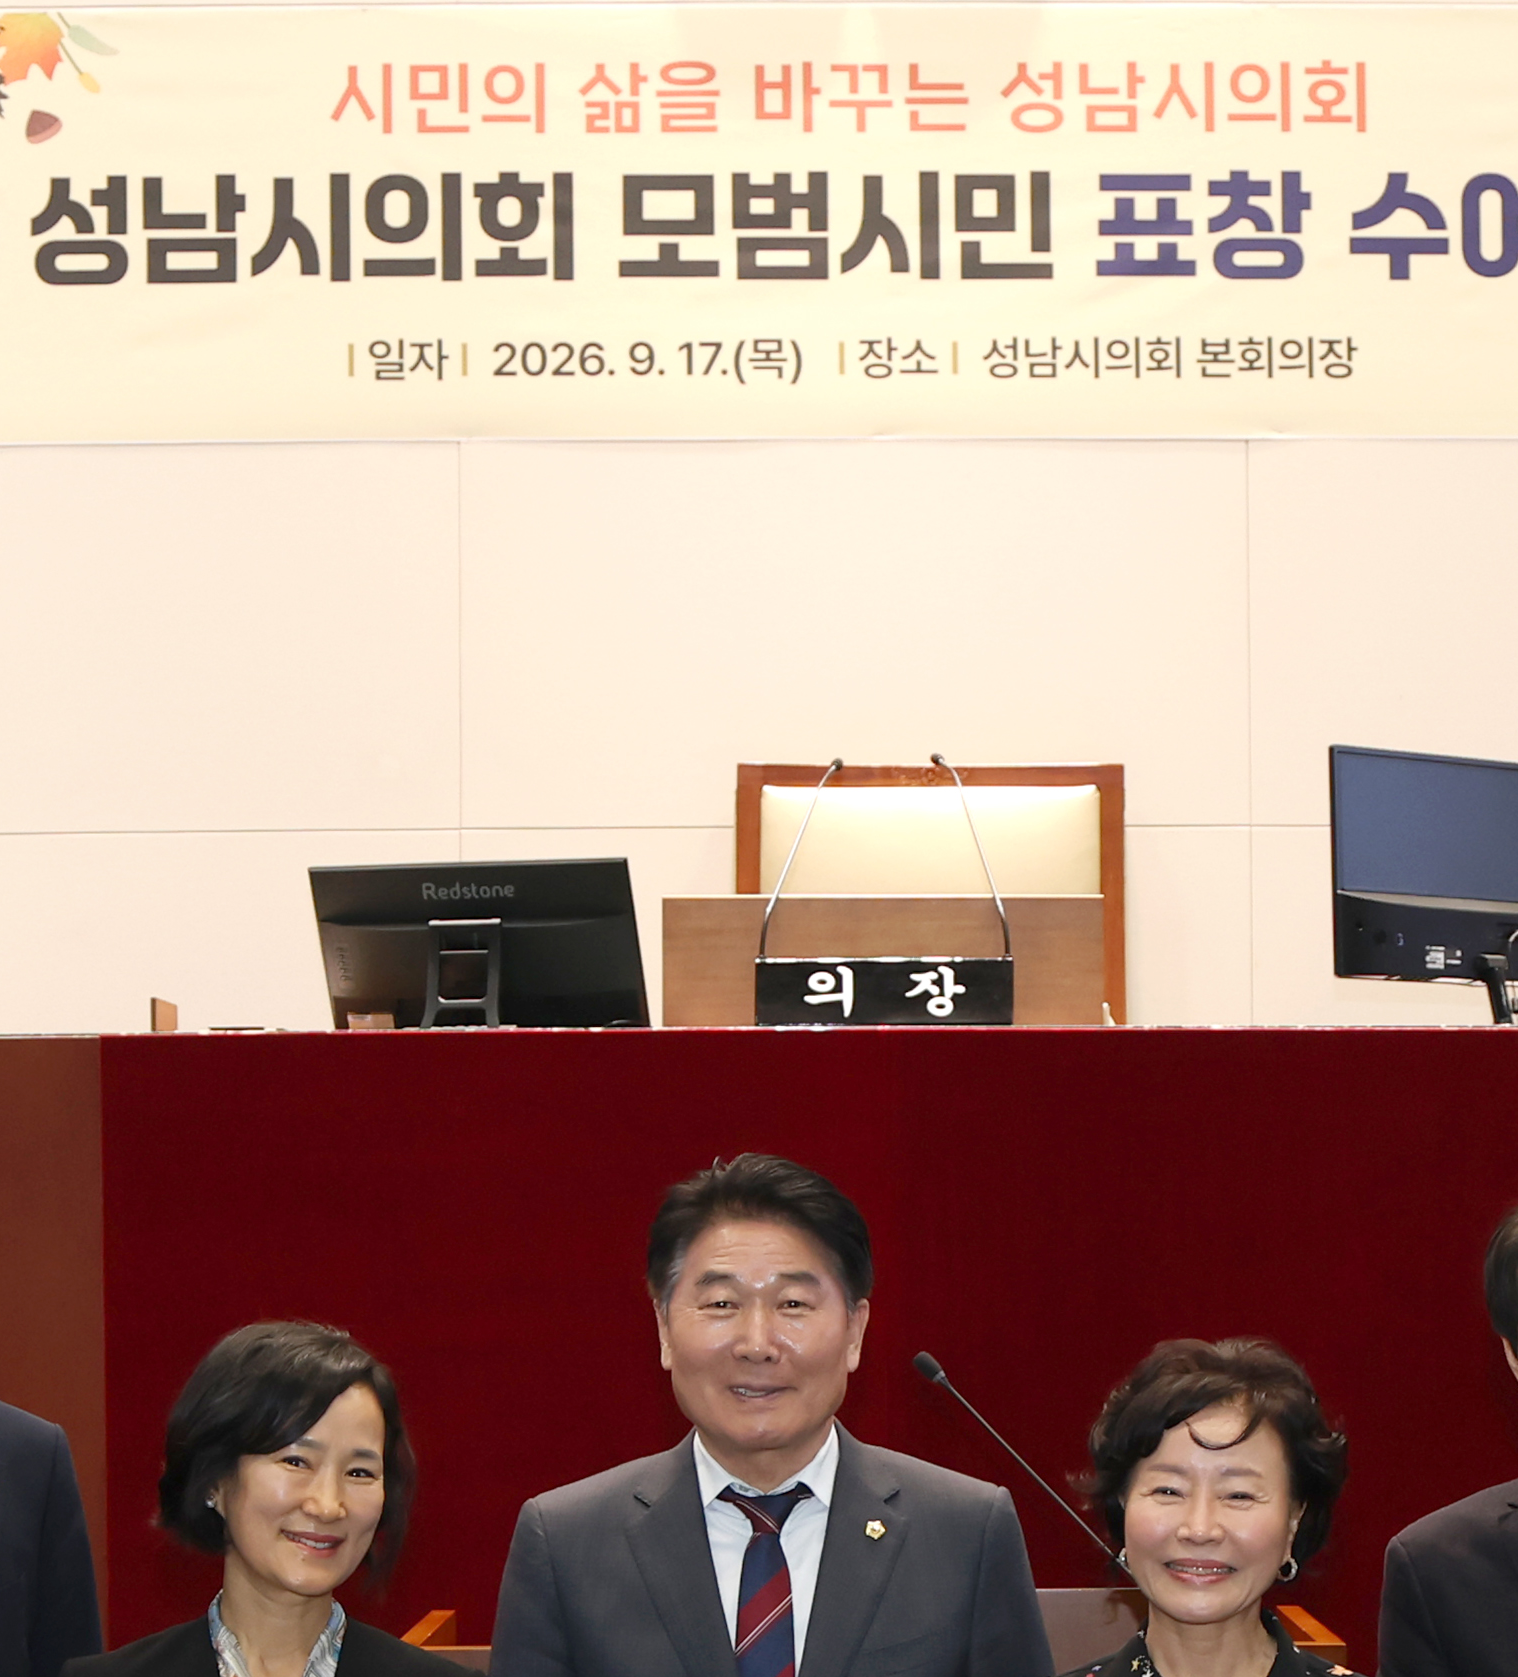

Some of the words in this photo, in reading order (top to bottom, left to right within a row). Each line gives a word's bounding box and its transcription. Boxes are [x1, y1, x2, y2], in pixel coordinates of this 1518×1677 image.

[331, 61, 546, 135] 시민의
[579, 60, 721, 134] 삶을
[754, 59, 970, 134] 바꾸는
[999, 58, 1368, 134] 성남시의회
[30, 171, 575, 286] 성남시의회
[618, 170, 1054, 281] 모범시민
[1096, 170, 1312, 281] 표창
[367, 338, 450, 381] 일자
[492, 341, 616, 377] 2026.
[628, 341, 666, 377] 9.
[677, 338, 803, 384] 17.(목)
[858, 335, 939, 380] 장소
[982, 335, 1183, 381] 성남시의회
[1195, 335, 1358, 381] 본회의장
[421, 881, 515, 901] Redstone
